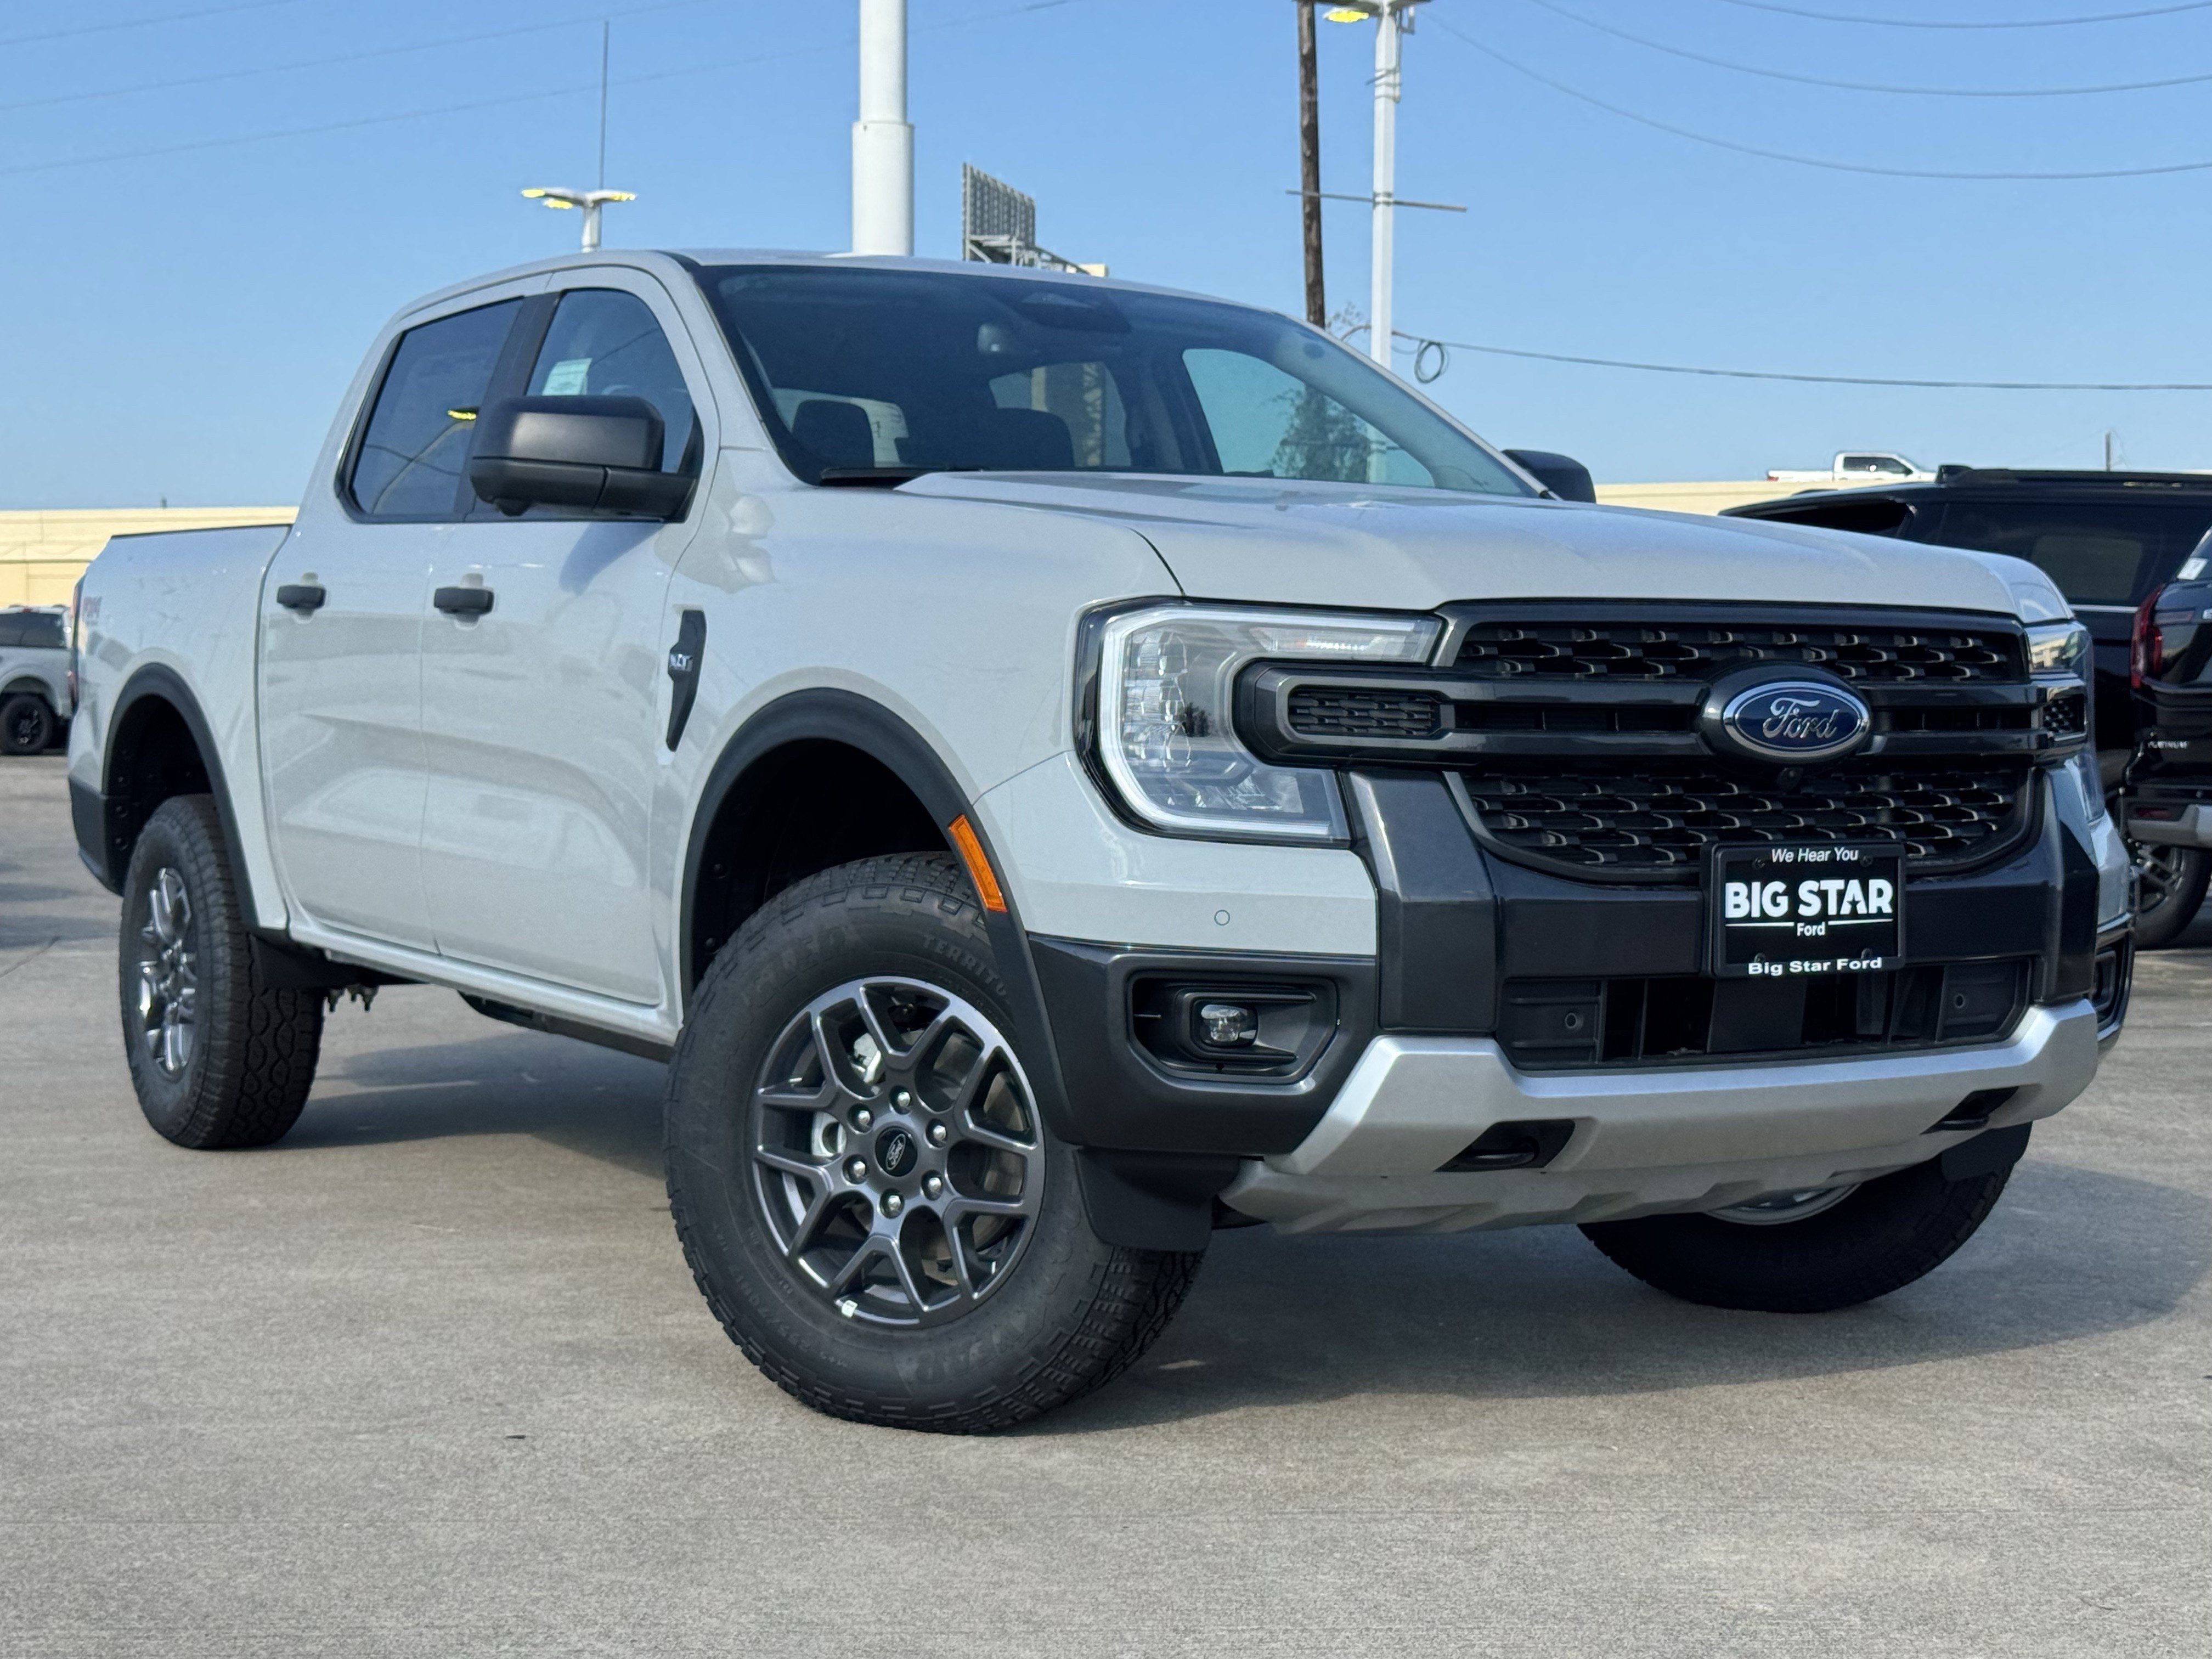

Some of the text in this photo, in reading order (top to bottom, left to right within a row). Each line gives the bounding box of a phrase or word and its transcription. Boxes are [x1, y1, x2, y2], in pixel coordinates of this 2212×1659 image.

[1763, 697, 1840, 738] Ford
[1771, 847, 1859, 863] We Hear You
[1725, 879, 1893, 918] BIG STAR
[1797, 922, 1826, 936] Ford
[1748, 957, 1882, 976] Big Star Ford
